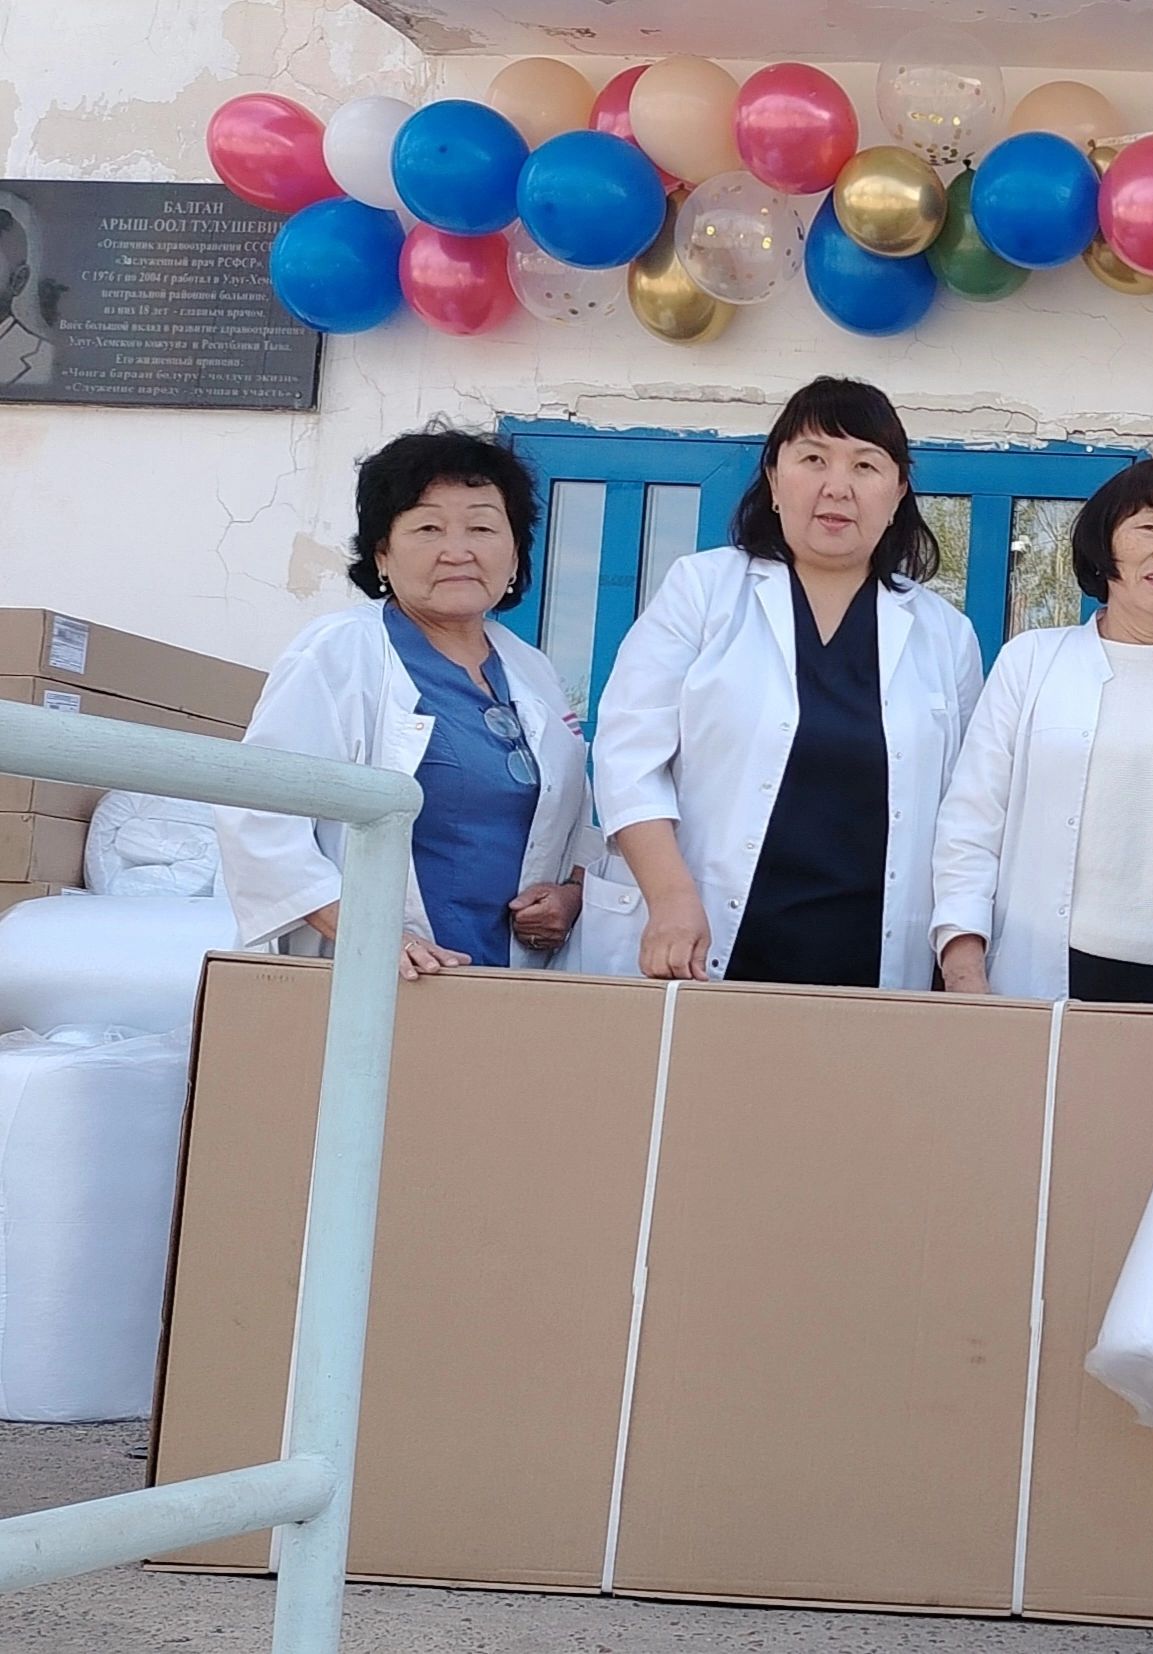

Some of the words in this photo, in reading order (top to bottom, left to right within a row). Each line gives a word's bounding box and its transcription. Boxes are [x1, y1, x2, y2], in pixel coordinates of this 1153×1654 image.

[163, 201, 224, 215] БАЛГАН
[98, 218, 187, 232] АРЫШ-ООЛ
[97, 238, 154, 250] «Отличник
[156, 241, 242, 253] здравоохранения
[115, 254, 188, 269] «Заслуженный
[191, 258, 214, 271] врач
[81, 270, 91, 281] С
[92, 270, 115, 282] 1976
[117, 273, 123, 281] г
[138, 271, 162, 282] 2004
[163, 275, 169, 283] г
[171, 272, 211, 286] работал
[213, 275, 220, 284] в
[101, 289, 166, 301] центральной
[169, 290, 218, 302] районной
[138, 304, 150, 315] 18
[151, 307, 169, 315] лет
[179, 308, 225, 317] главным
[85, 320, 129, 332] большой
[131, 323, 162, 333] вклад
[163, 324, 170, 332] в
[172, 324, 218, 335] развитие
[220, 326, 306, 338] здравоохранения
[69, 335, 142, 349] Улуг-Хемского
[202, 339, 260, 352] Республики
[116, 353, 135, 364] Его
[65, 382, 135, 395] «Служение
[137, 386, 180, 397] народу
